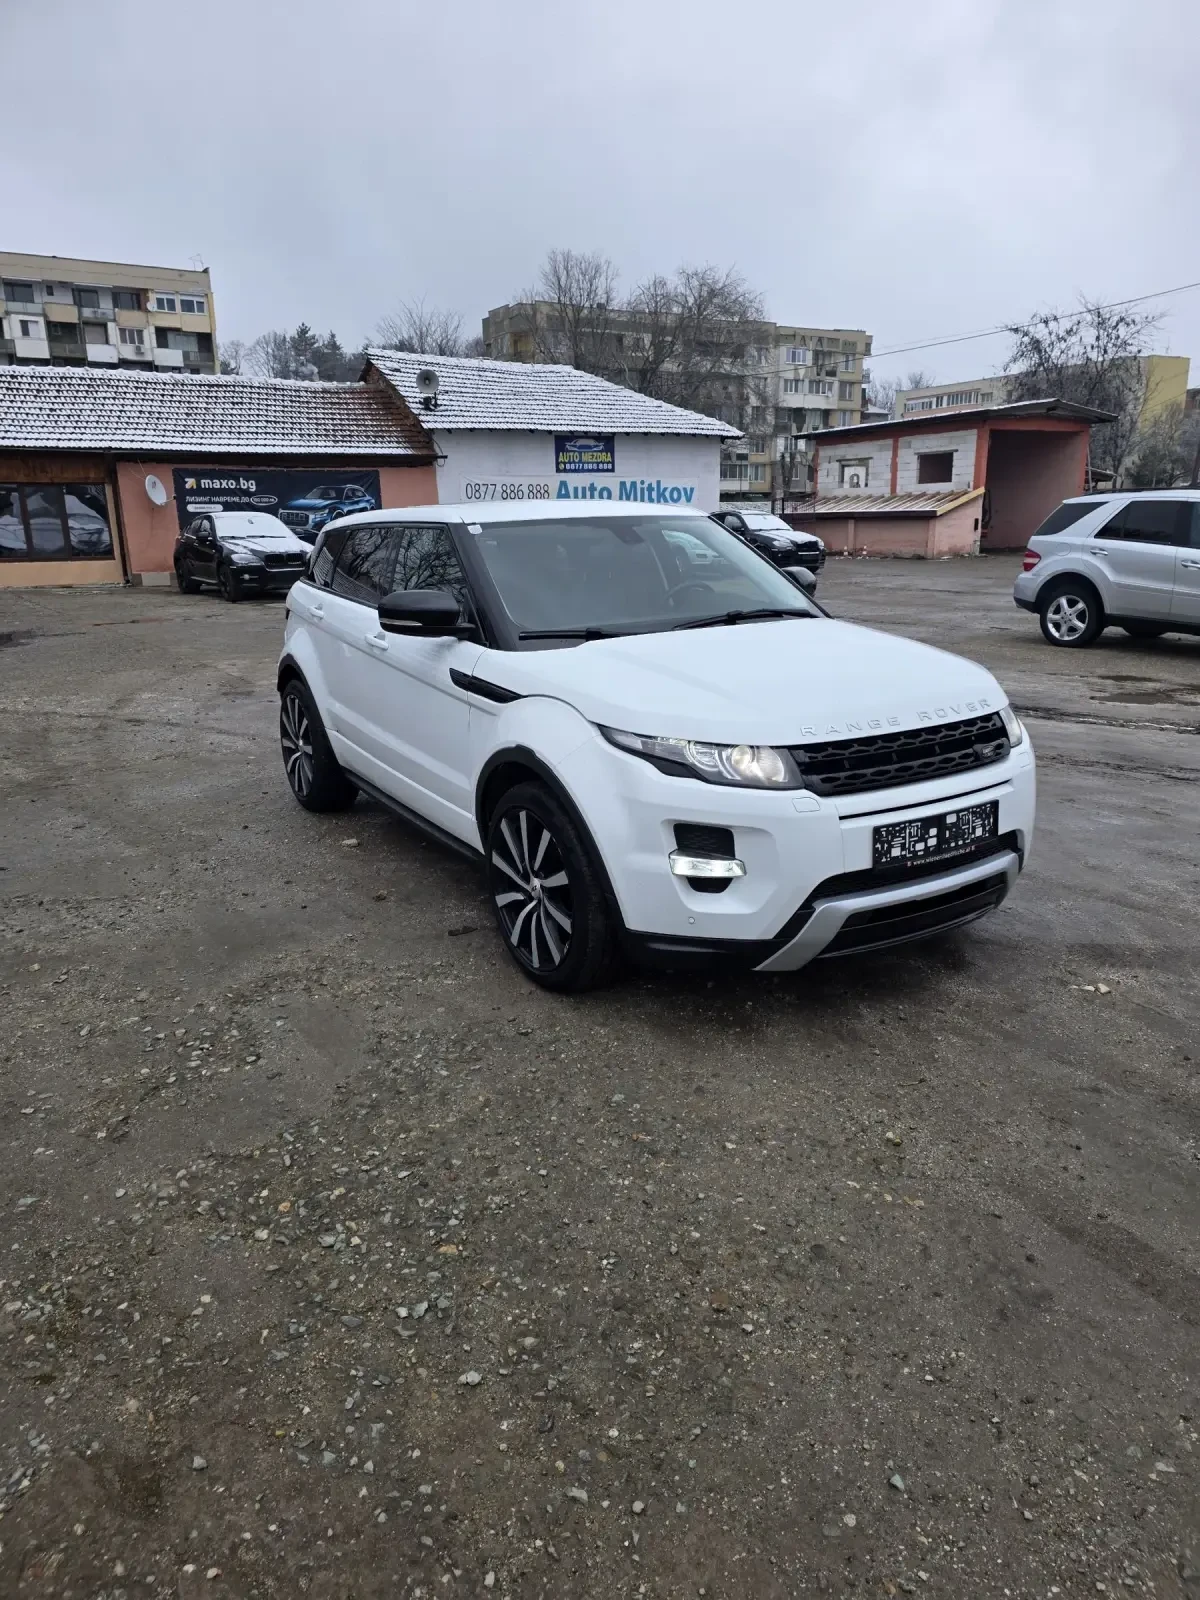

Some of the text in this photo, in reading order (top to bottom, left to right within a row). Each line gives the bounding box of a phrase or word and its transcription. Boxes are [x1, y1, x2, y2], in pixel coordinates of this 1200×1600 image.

[558, 451, 612, 463] AUTO MEZDRA
[201, 477, 256, 491] maxo.bg
[465, 479, 695, 504] 0877 886 888 Auto Mitkov
[799, 698, 992, 737] RANGE ROVER
